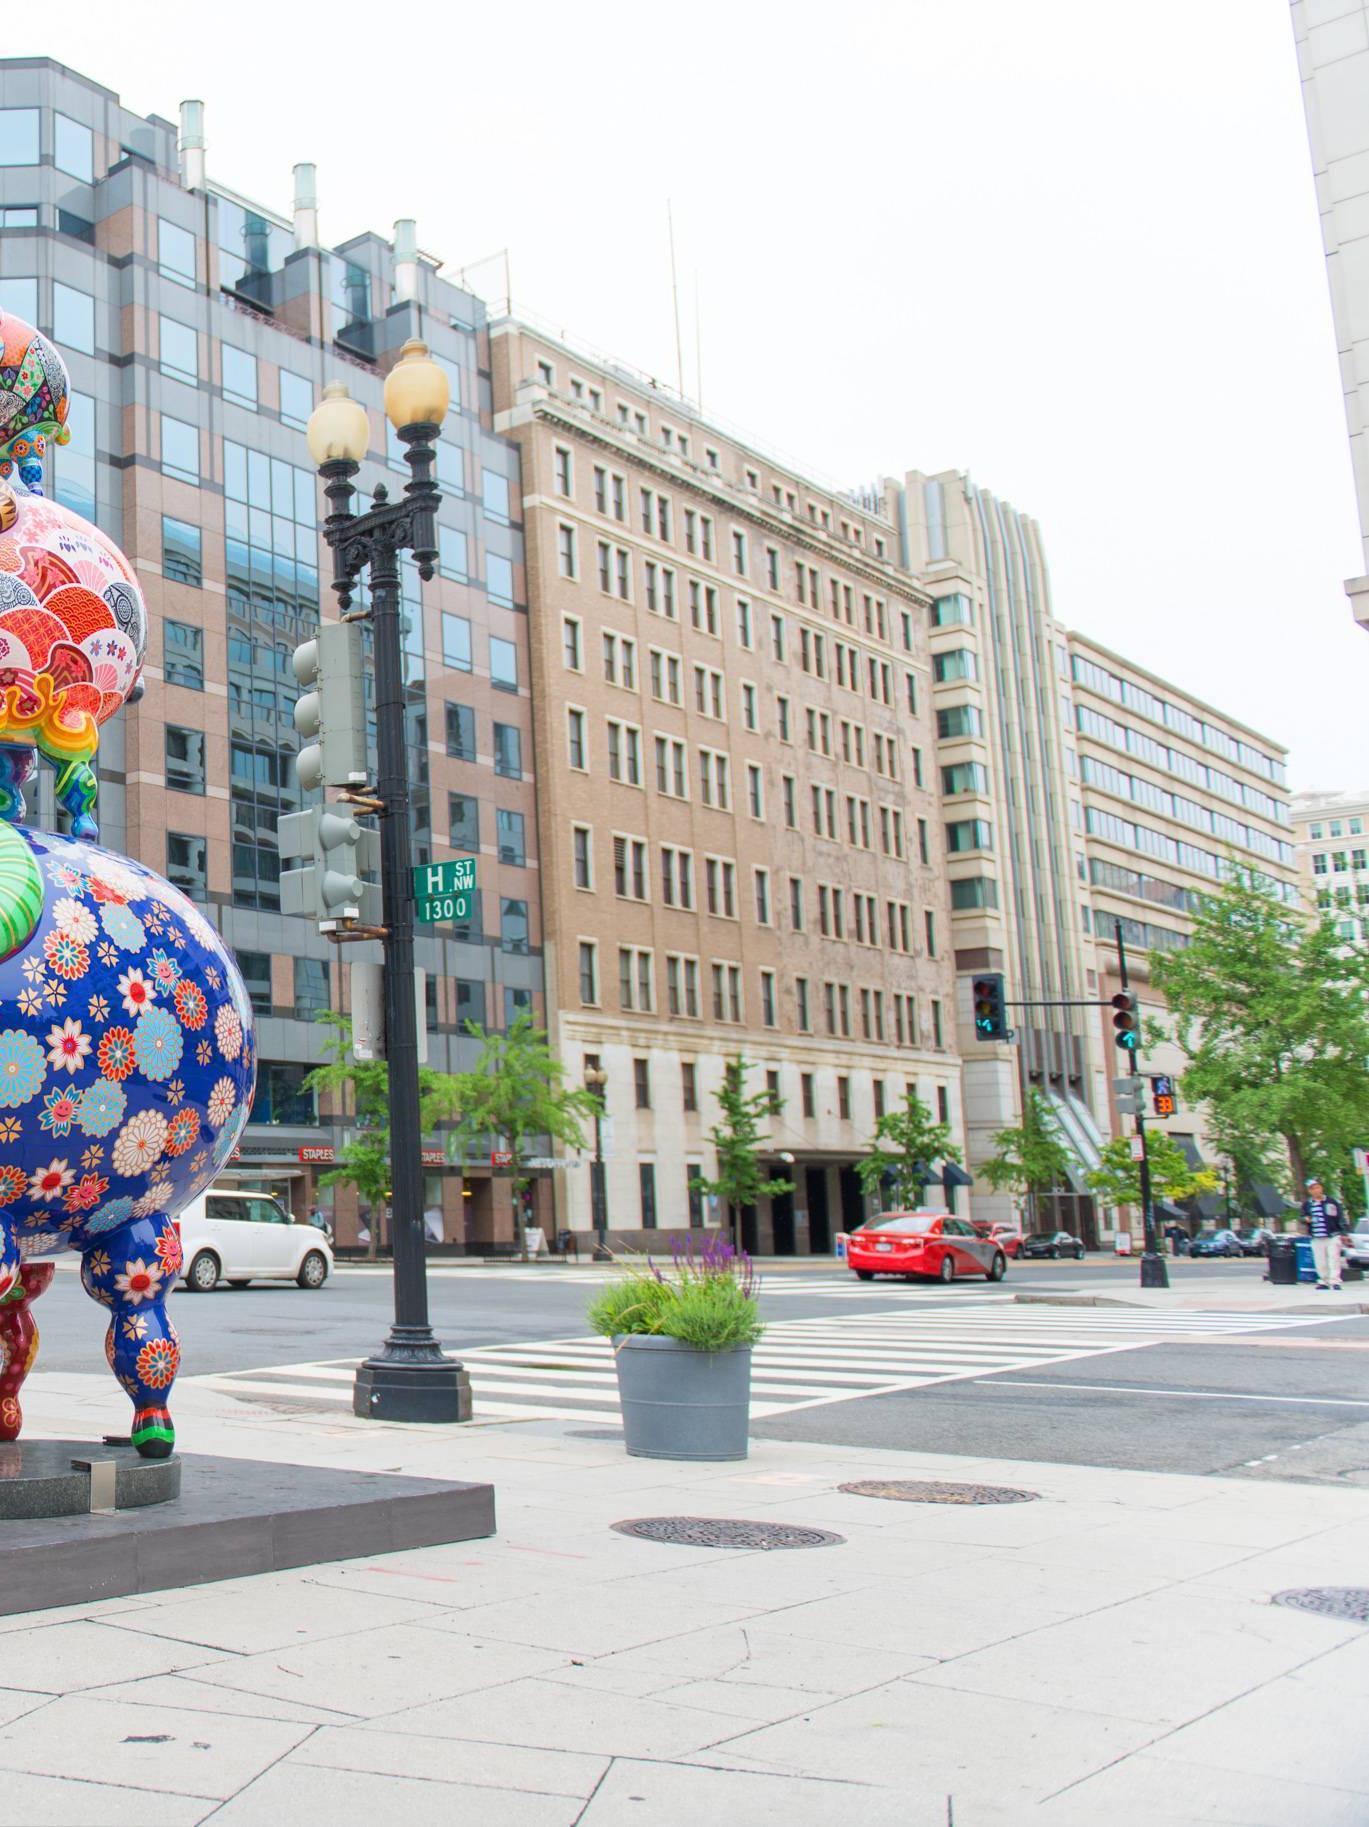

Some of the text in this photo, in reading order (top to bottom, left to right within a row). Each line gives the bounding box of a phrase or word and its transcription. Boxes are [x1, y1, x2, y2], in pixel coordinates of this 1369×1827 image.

[427, 861, 472, 893] H ST
[454, 875, 473, 891] NW
[425, 898, 466, 920] 1300
[303, 1148, 335, 1161] STAPLES
[421, 1152, 445, 1162] TAPLES
